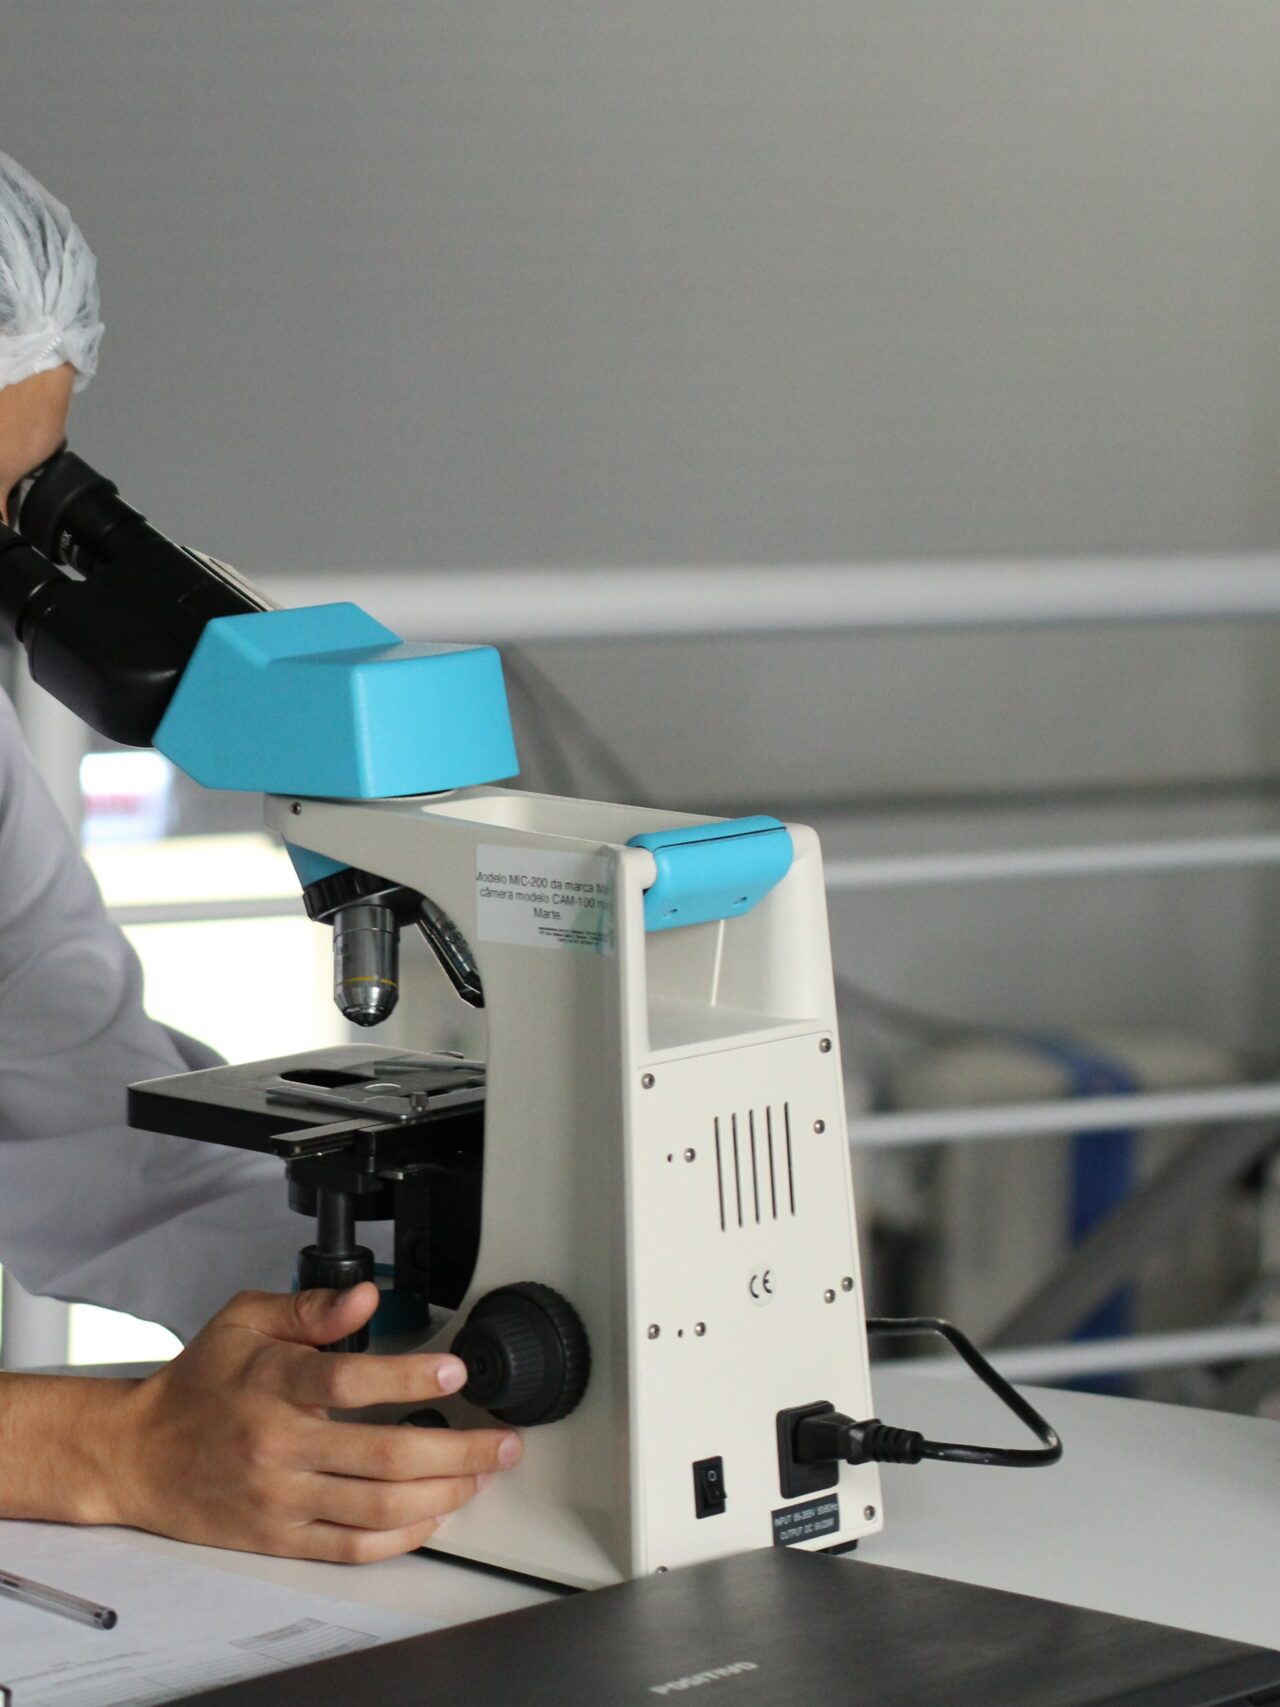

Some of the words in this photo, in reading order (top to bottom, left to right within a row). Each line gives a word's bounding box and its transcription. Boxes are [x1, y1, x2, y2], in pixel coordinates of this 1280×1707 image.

[509, 873, 548, 889] MIC-200
[550, 879, 562, 890] da
[565, 881, 593, 893] marca
[479, 886, 514, 900] câmera
[515, 890, 550, 904] modelo
[552, 893, 596, 909] CAM-100
[533, 907, 561, 920] Marte
